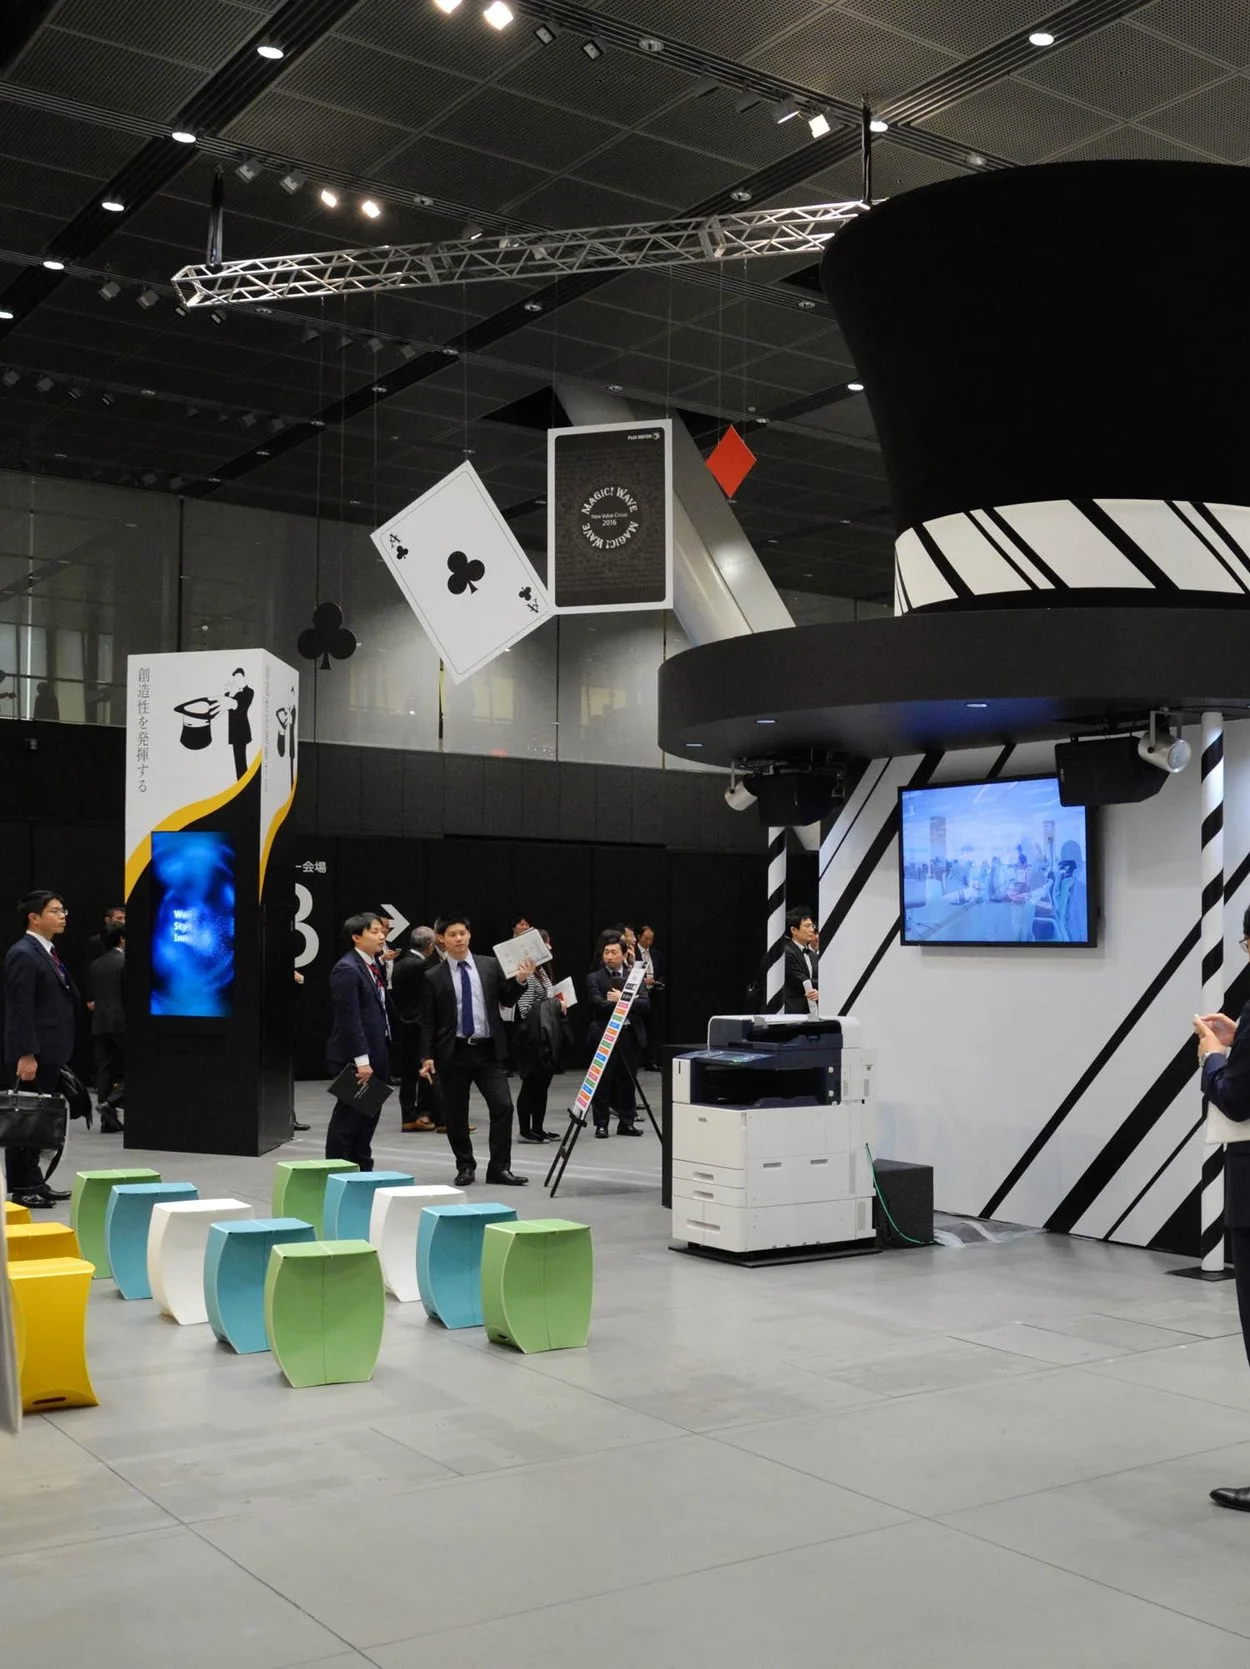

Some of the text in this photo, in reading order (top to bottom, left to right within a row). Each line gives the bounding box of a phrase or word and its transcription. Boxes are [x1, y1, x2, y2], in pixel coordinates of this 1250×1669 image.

[581, 486, 638, 515] MAGIC! WAVE
[582, 521, 639, 549] MAGIC! WAVE
[602, 519, 617, 527] 2016
[136, 667, 151, 794] 創造性を発揮する
